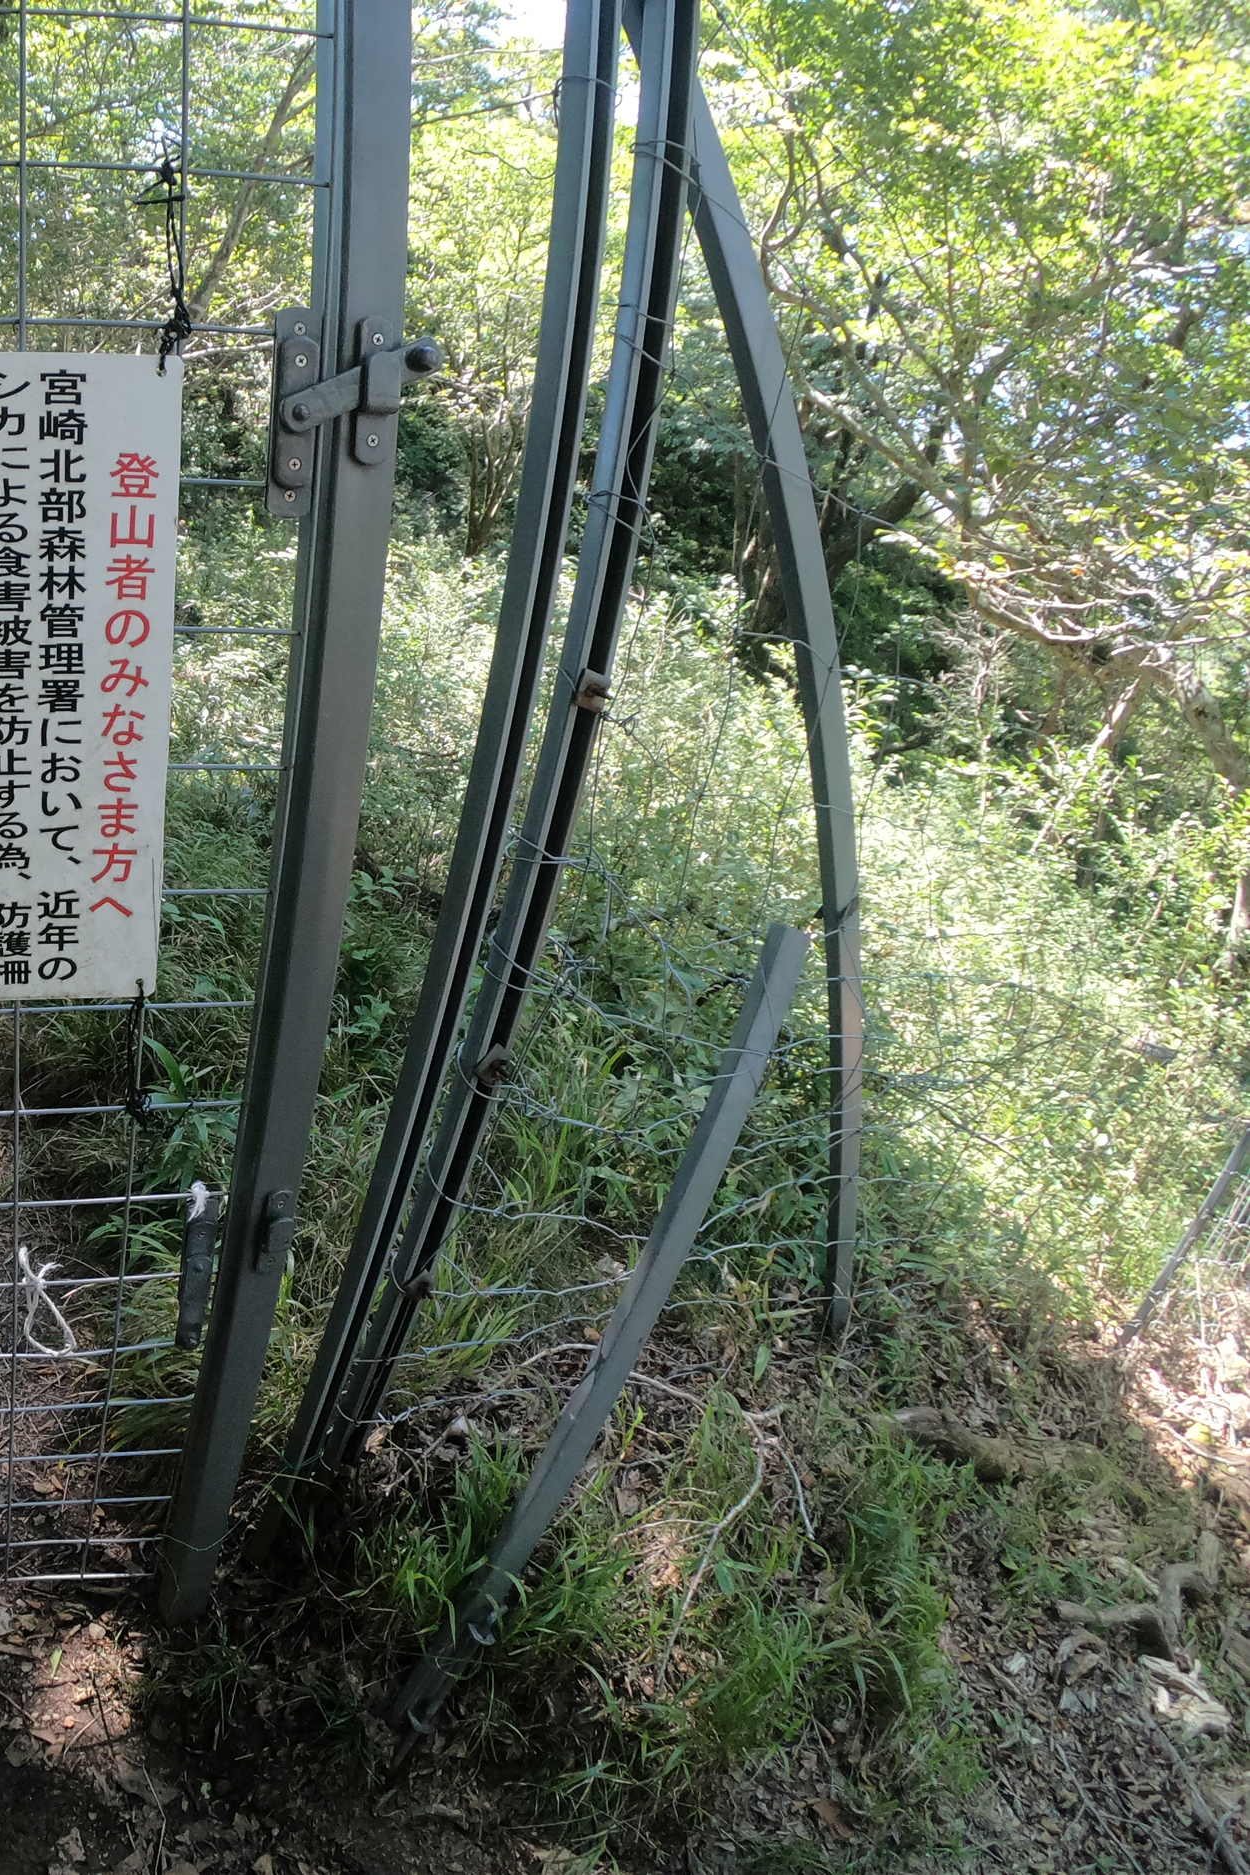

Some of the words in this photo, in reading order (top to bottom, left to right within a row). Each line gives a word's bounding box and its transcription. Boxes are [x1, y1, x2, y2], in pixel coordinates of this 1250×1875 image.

[37, 369, 88, 982] 宮崎北部森林管理署において、近年の
[89, 452, 160, 918] 登山者のみなさま方へ
